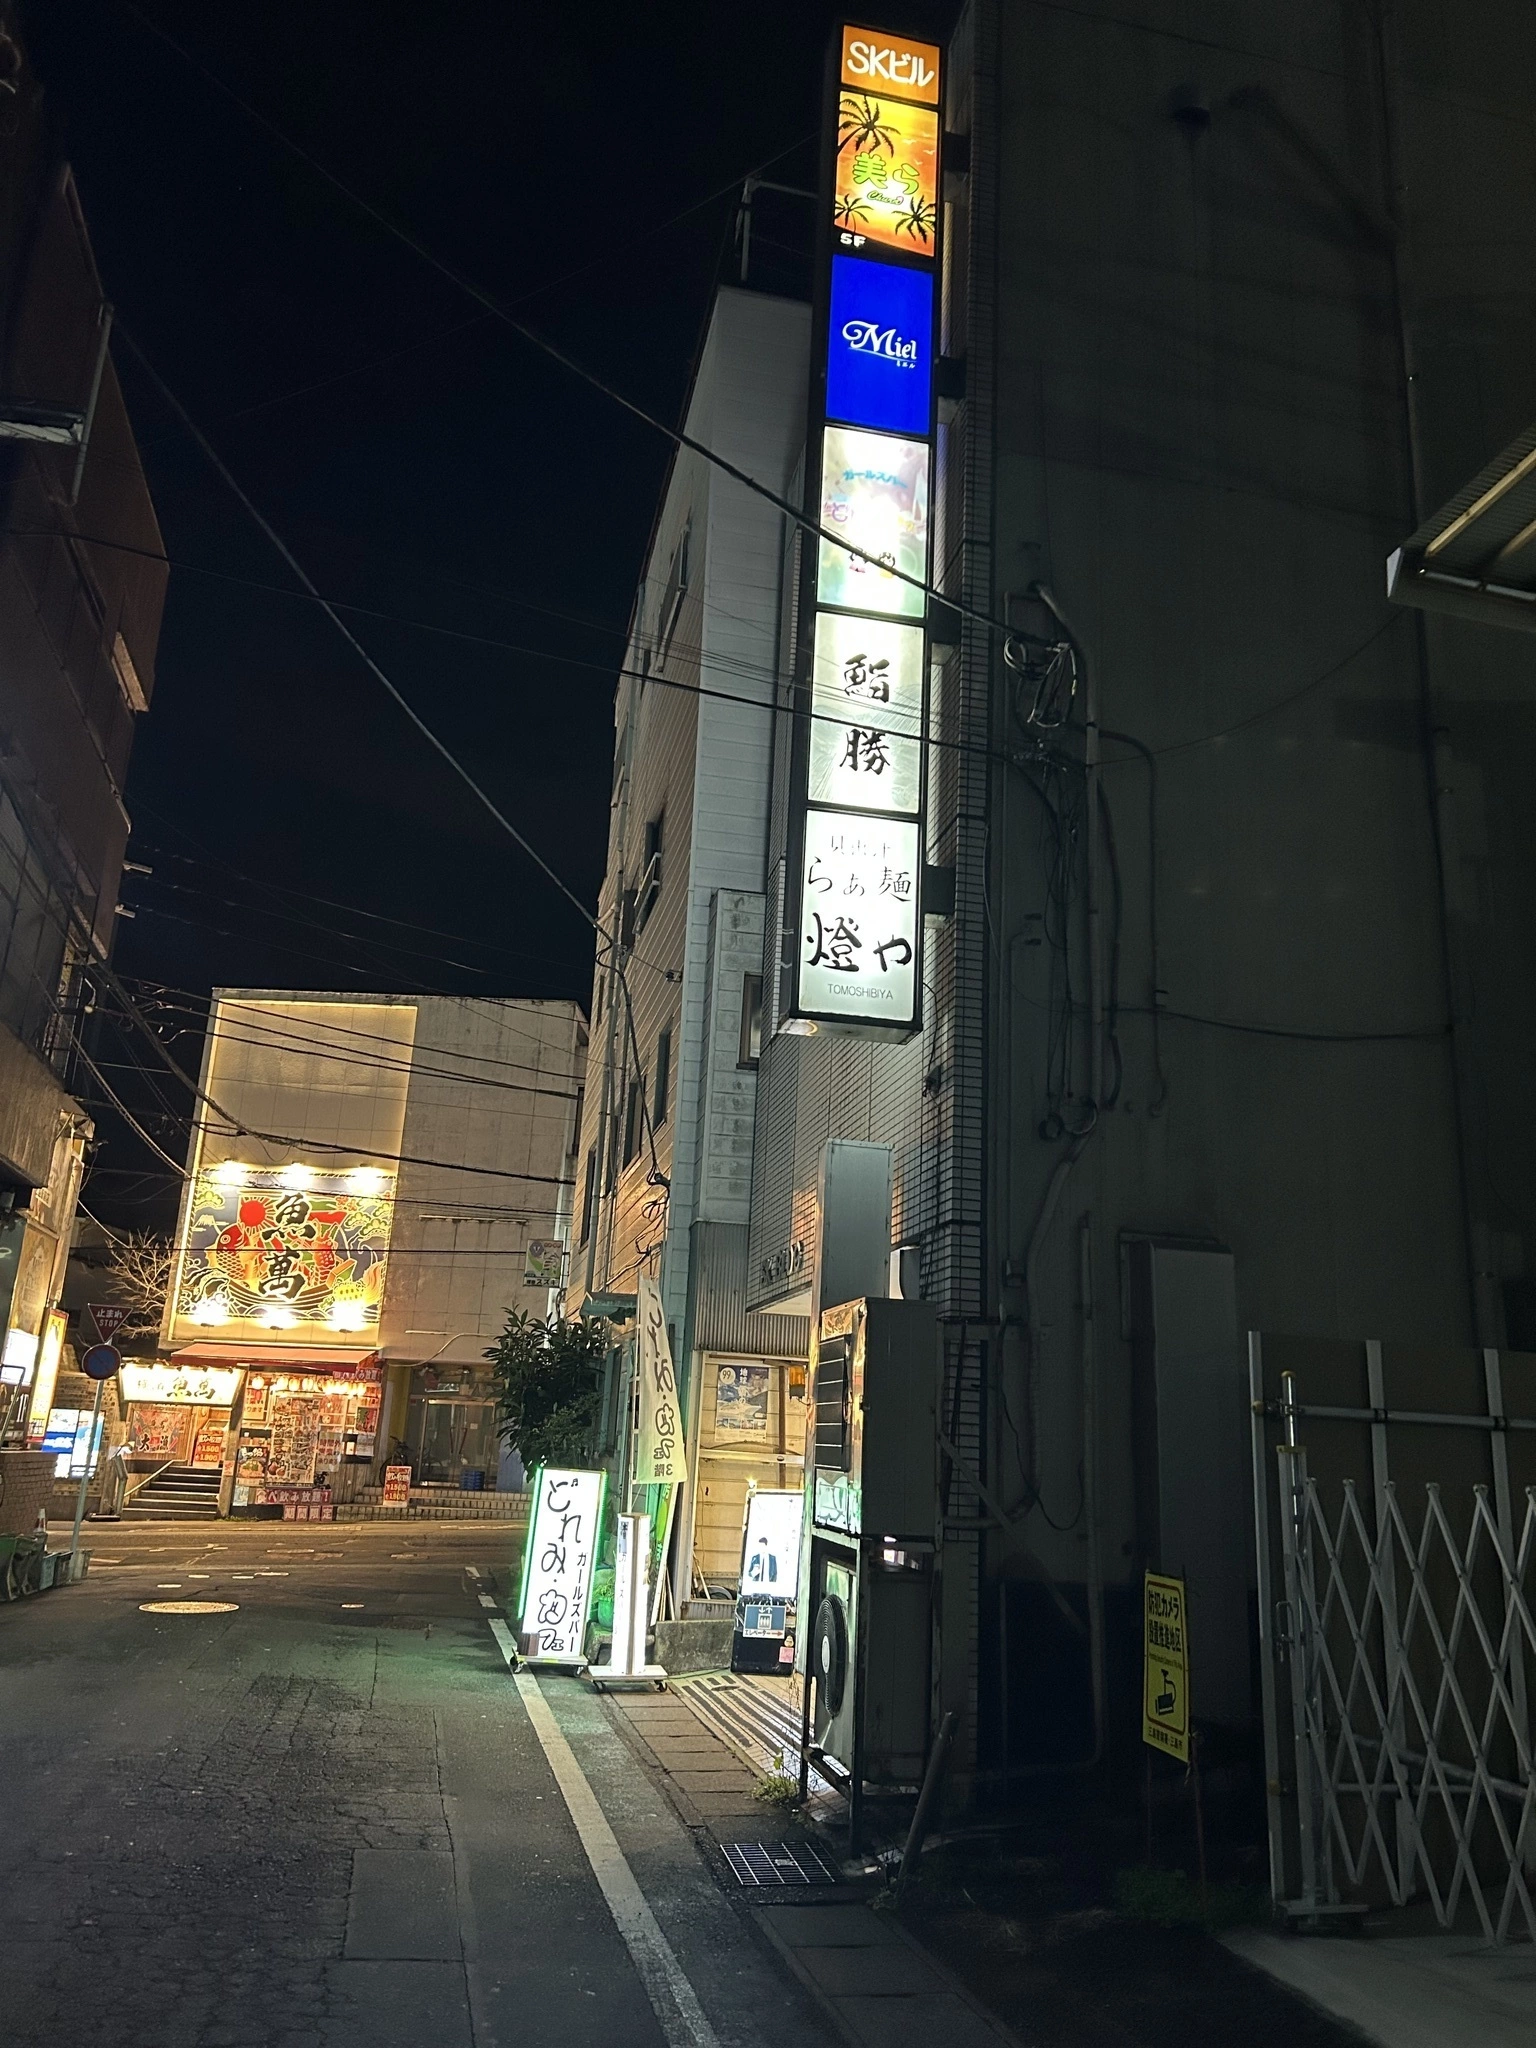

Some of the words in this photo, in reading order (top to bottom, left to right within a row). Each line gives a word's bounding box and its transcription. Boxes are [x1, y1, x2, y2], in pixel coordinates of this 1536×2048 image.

[846, 40, 935, 87] SKビル
[853, 150, 920, 195] 美ら
[840, 232, 866, 248] 5F
[842, 320, 917, 360] Miel
[839, 653, 891, 775] 鮨勝
[807, 856, 911, 902] らぁ麺
[804, 912, 912, 972] 燈や
[827, 983, 894, 1000] TOMOSHIBIYA
[96, 1308, 123, 1318] 止まれ
[99, 1319, 118, 1327] STOP
[722, 1370, 731, 1380] 99
[568, 1552, 587, 1653] ガールズバー
[1148, 1590, 1180, 1621] 防犯カメラ
